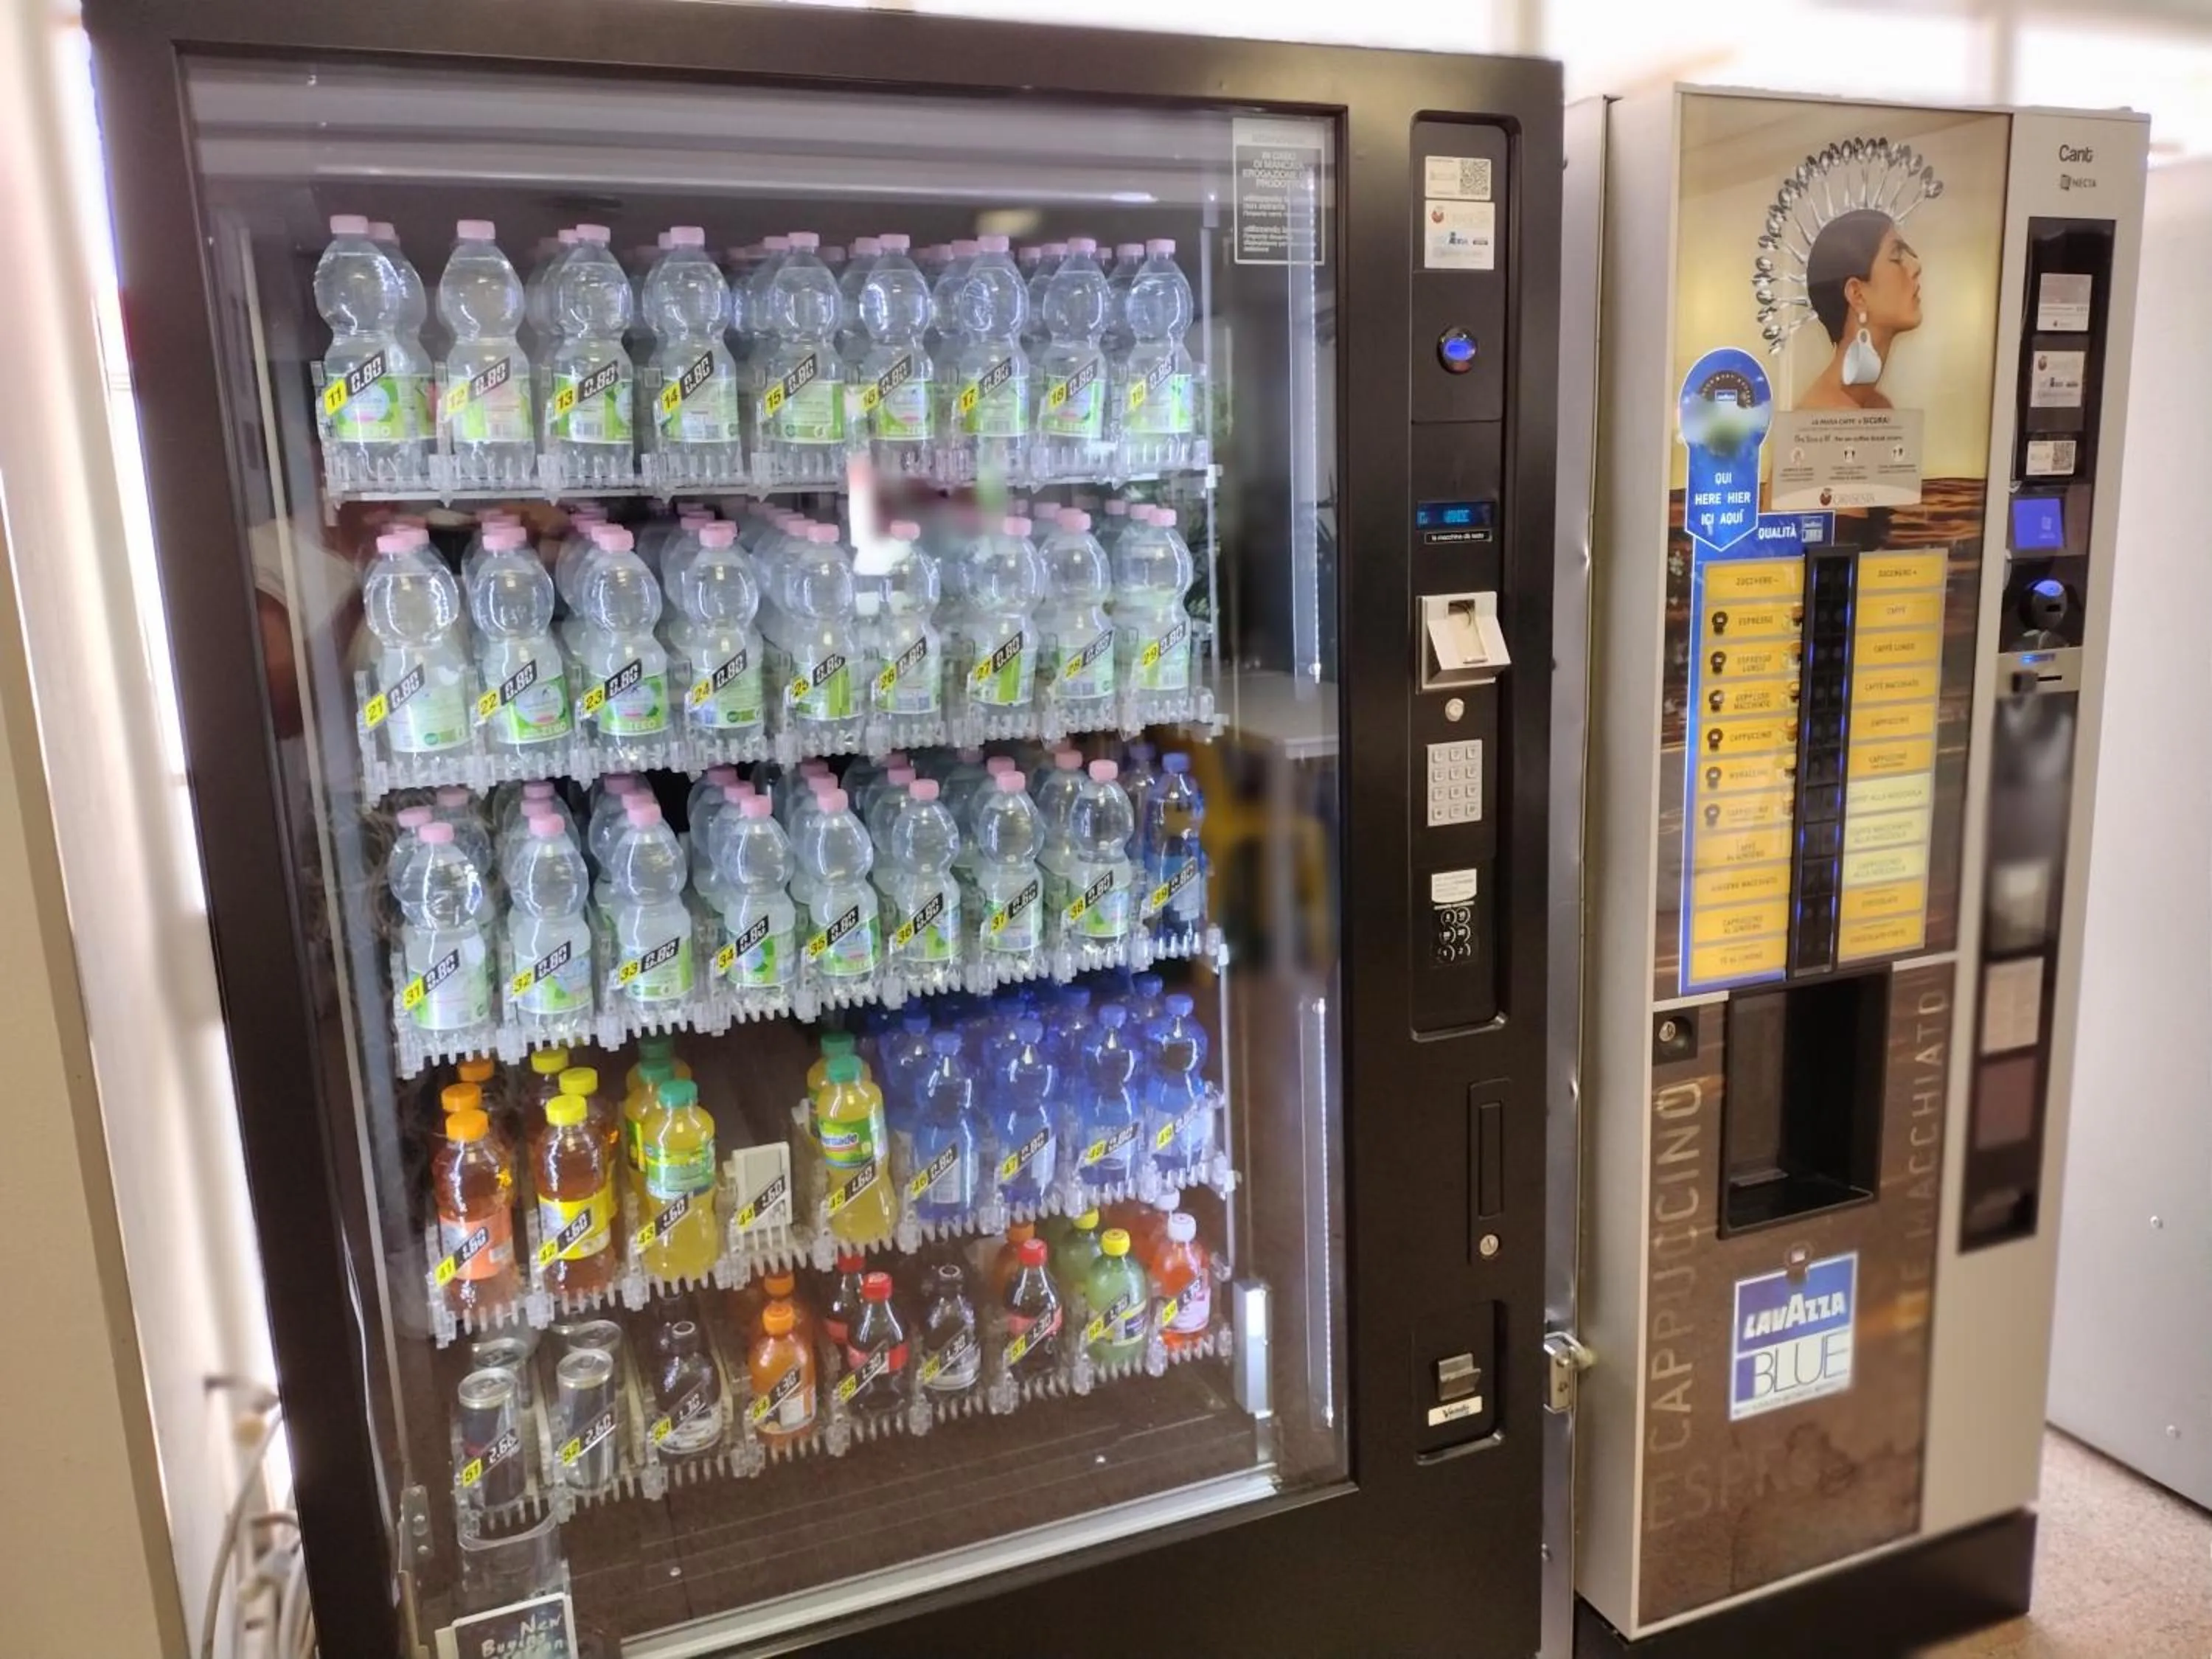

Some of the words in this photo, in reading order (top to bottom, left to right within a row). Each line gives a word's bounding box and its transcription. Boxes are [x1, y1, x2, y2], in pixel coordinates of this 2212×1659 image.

[327, 386, 343, 408] 11
[350, 355, 382, 394] 0.80
[447, 389, 465, 410] 12
[474, 363, 506, 396] 0.80
[557, 390, 574, 410] 13
[582, 365, 616, 397] 0.80
[664, 389, 679, 408] 14
[684, 357, 709, 394] 0.80
[766, 388, 782, 408] 15
[787, 358, 815, 394] 0.80
[961, 388, 975, 407] 17
[1714, 472, 1733, 485] QUI
[1694, 493, 1721, 506] HERE
[1727, 491, 1751, 504] HIER
[1758, 522, 1797, 539] QUALITÀ
[368, 700, 384, 722] 21
[389, 670, 420, 709] 0.80
[479, 692, 498, 715] 22
[504, 664, 532, 700] 0.80
[583, 689, 603, 710] 23
[693, 684, 709, 703] 24
[718, 949, 734, 969] 34
[405, 983, 422, 1005] 31
[738, 1206, 754, 1228] 44
[1742, 1290, 1846, 1341] LAVAZZA
[1752, 1332, 1849, 1397] BLUE
[585, 1413, 612, 1445] 2.60
